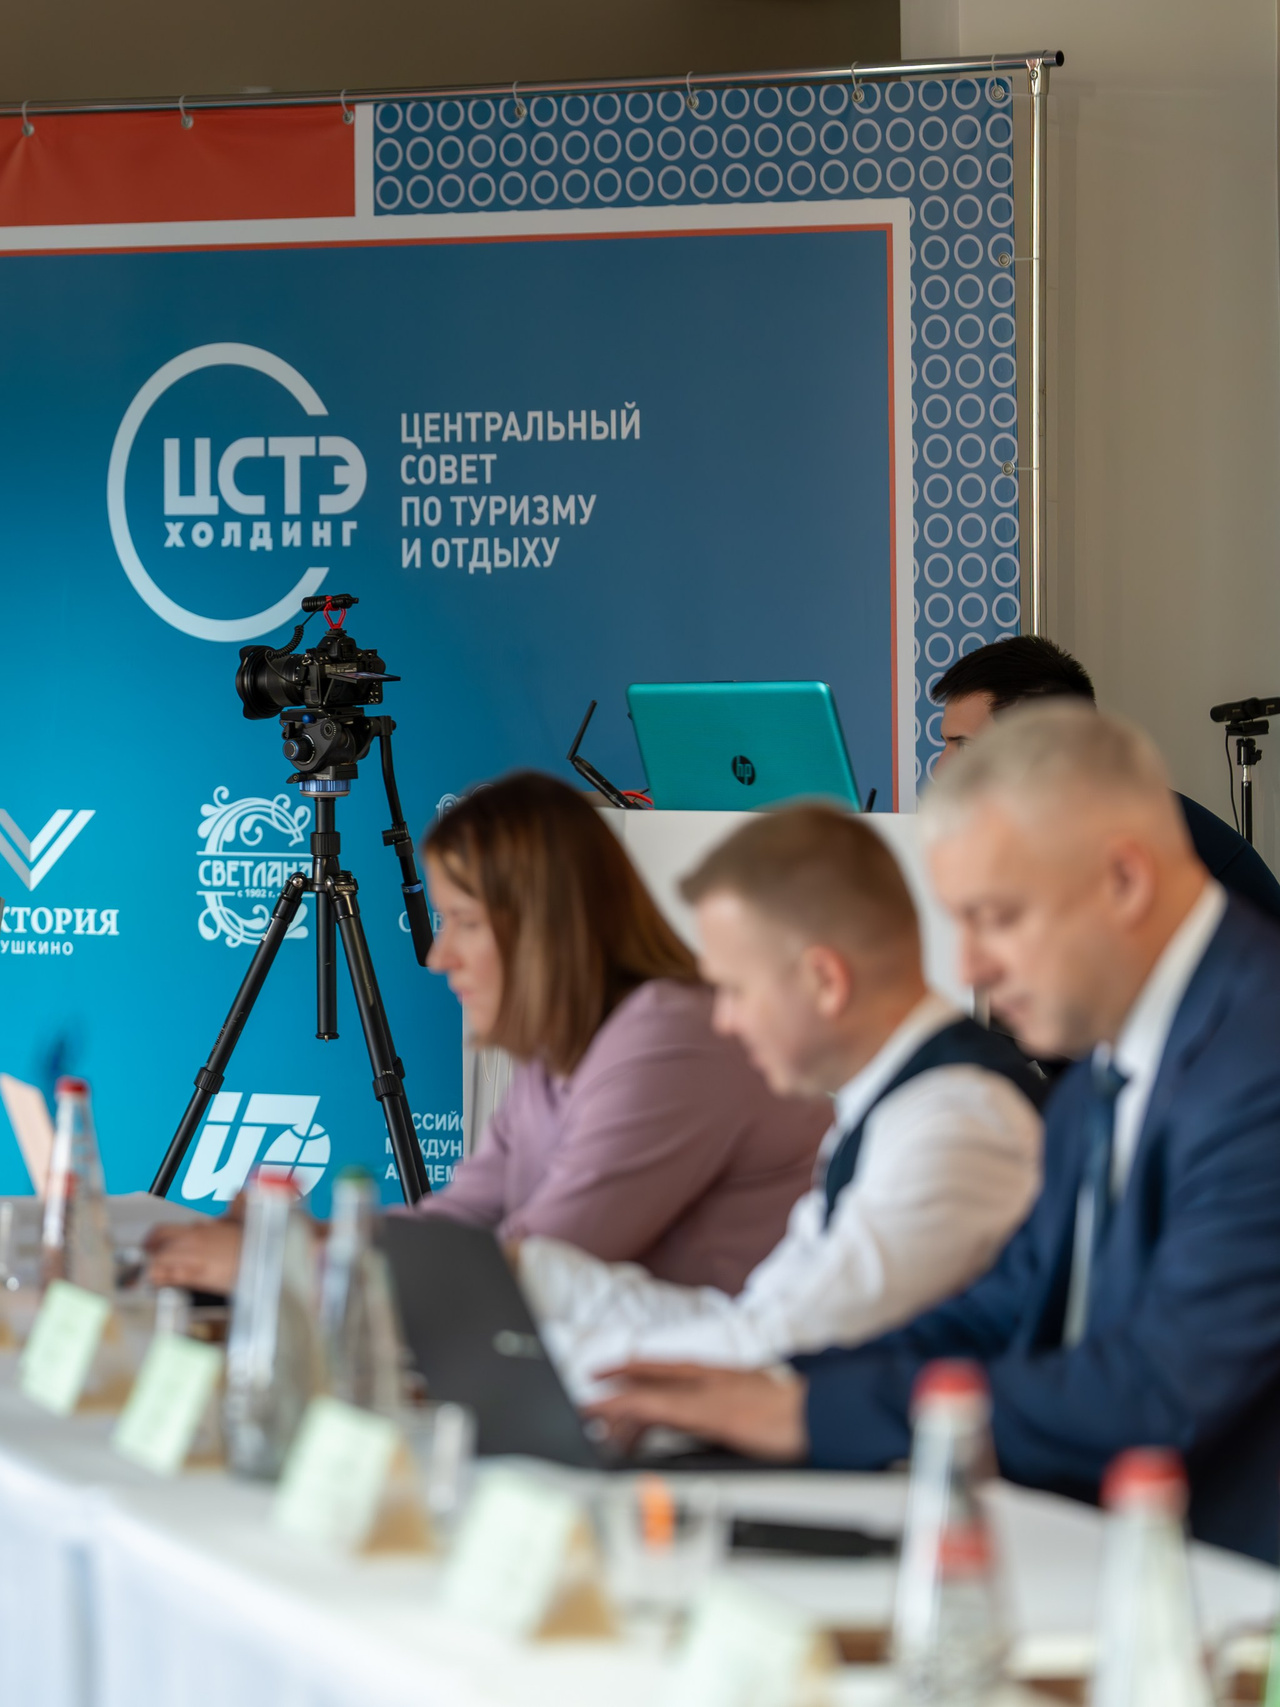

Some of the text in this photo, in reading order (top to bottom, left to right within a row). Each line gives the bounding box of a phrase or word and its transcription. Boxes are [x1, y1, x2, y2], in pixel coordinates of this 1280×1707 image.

[400, 402, 642, 449] ЦЕНТРАЛЬНЫЙ
[163, 435, 367, 516] ЦСТЭ
[400, 453, 497, 485] СОВЕТ
[400, 494, 597, 527] ПО ТУРИЗМУ
[163, 520, 358, 551] ХОЛДИНГ
[400, 537, 561, 575] И ОТДЫХУ
[733, 755, 754, 785] hp
[385, 1110, 464, 1131] ССИЙ
